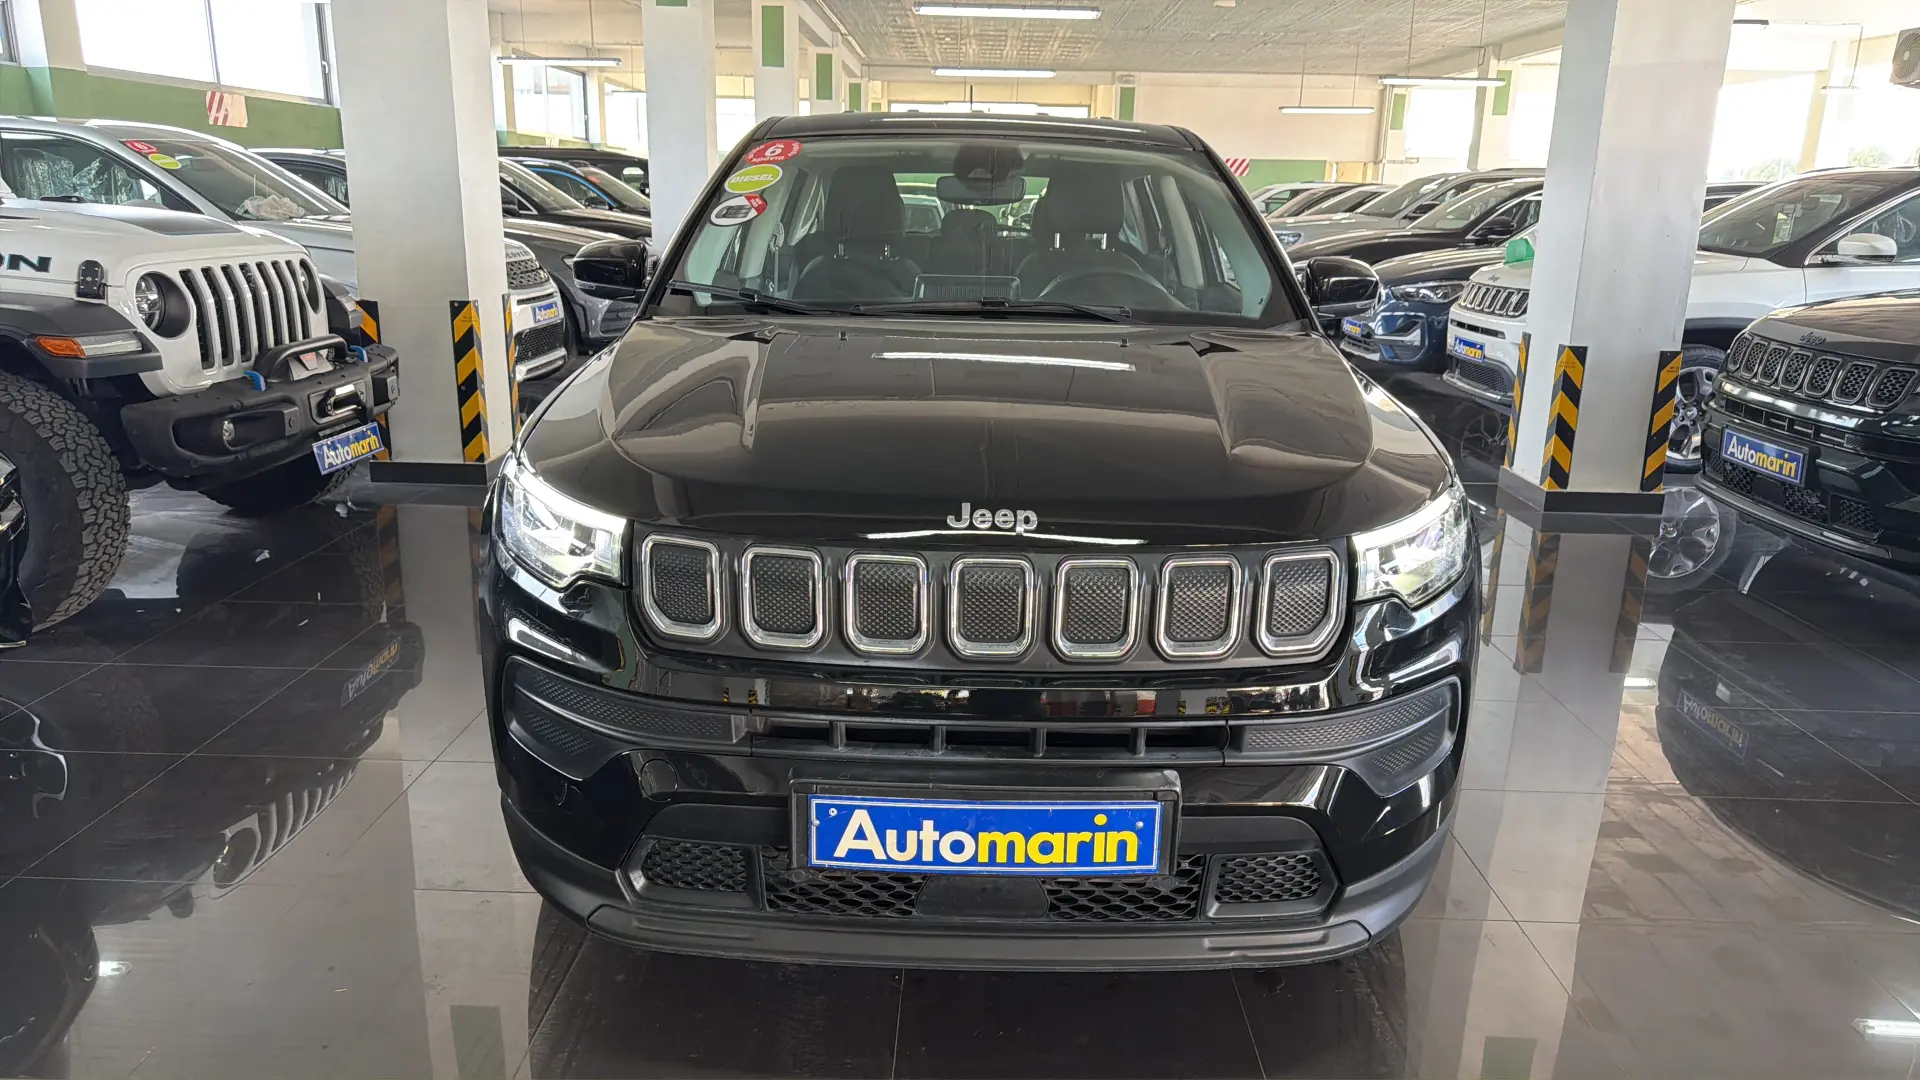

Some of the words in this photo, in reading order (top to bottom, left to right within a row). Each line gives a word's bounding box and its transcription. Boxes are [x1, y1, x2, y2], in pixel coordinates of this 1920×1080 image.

[765, 142, 785, 157] 6
[730, 173, 775, 184] DIESEL
[323, 429, 379, 469] Automarin
[1727, 435, 1797, 478] Automarin
[946, 502, 1038, 535] Jeep
[833, 808, 1138, 864] Automarin
